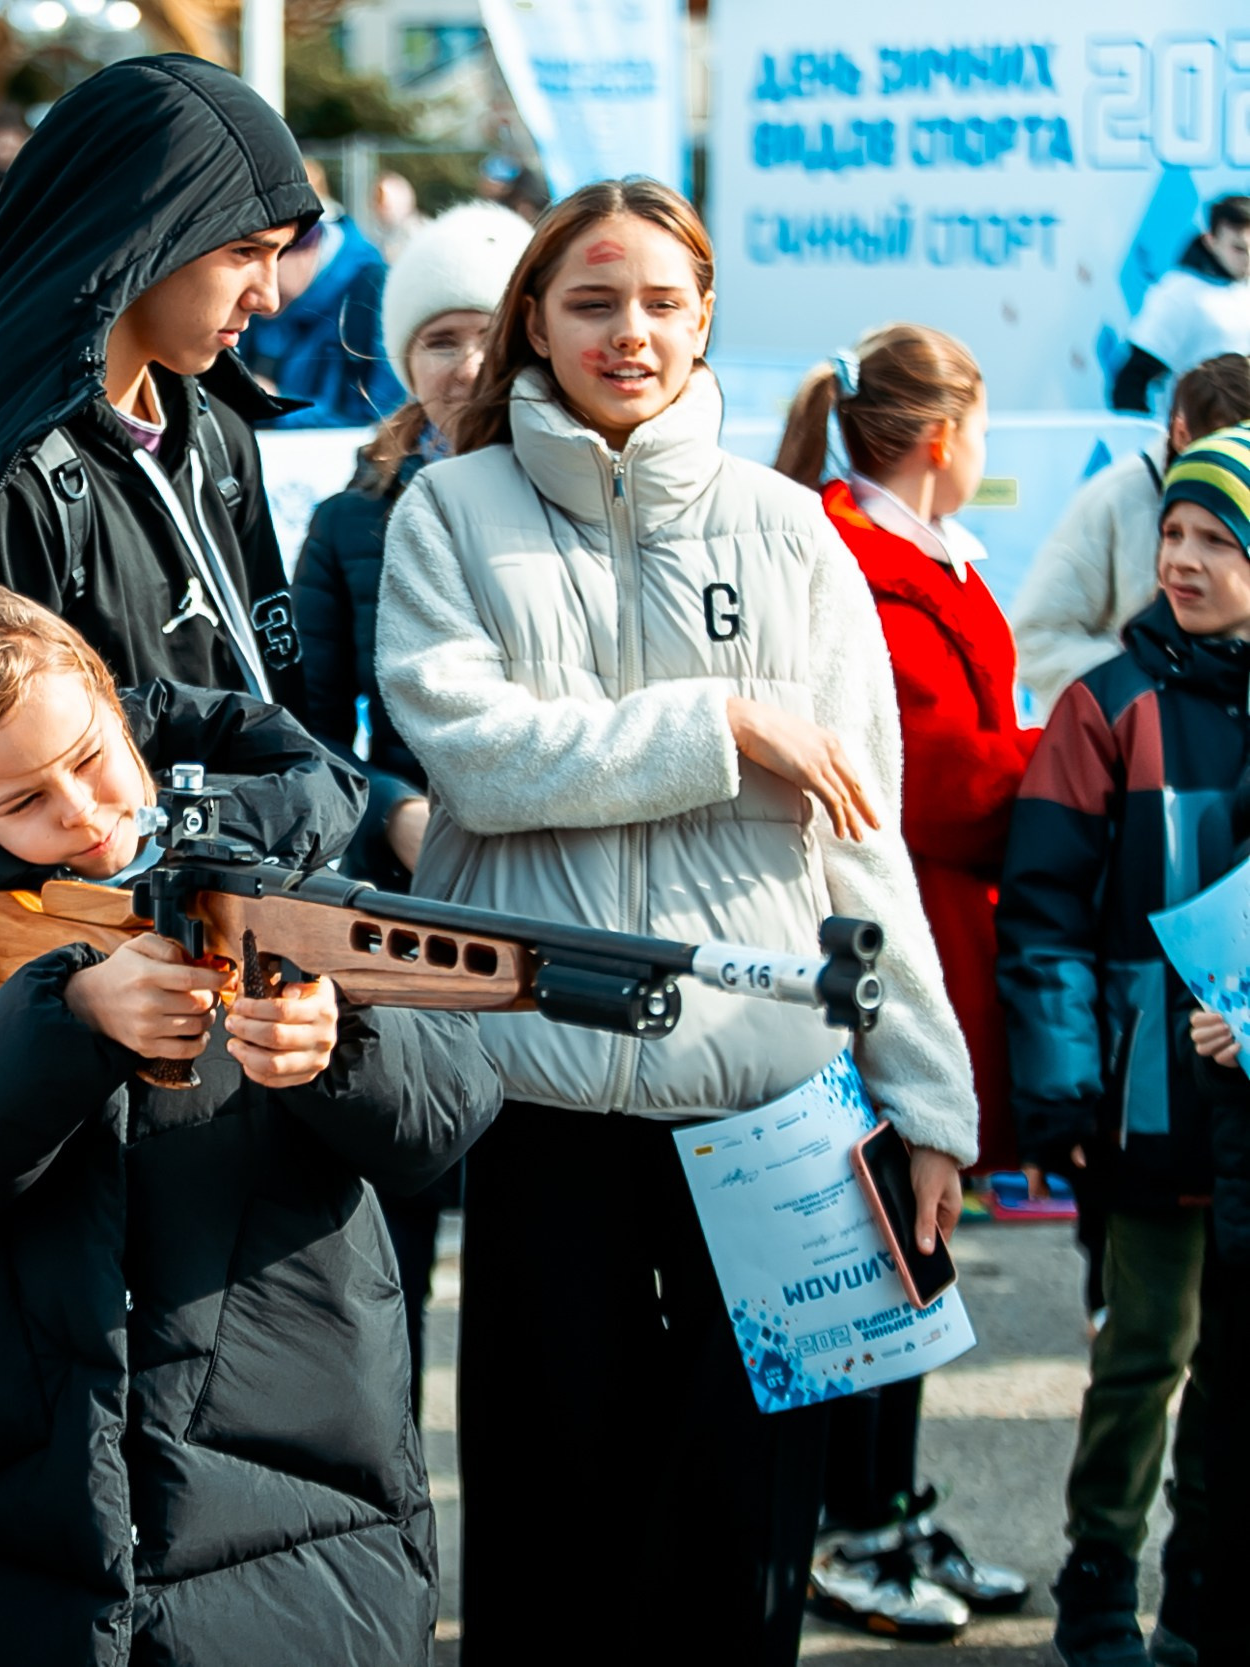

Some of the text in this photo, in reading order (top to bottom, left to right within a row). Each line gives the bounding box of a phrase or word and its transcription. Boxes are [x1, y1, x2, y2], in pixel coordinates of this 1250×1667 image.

[752, 42, 1057, 102] ДЕНЬ ЗИМНИХ
[752, 116, 1074, 173] ВИДОВ СПОРТА
[924, 211, 1060, 267] СПОРТ
[703, 582, 740, 642] G
[744, 964, 771, 989] 16
[782, 1251, 896, 1306] ДИПЛОМ
[852, 1305, 900, 1331] СПОРТА
[861, 1317, 916, 1342] ЗИМНИХ
